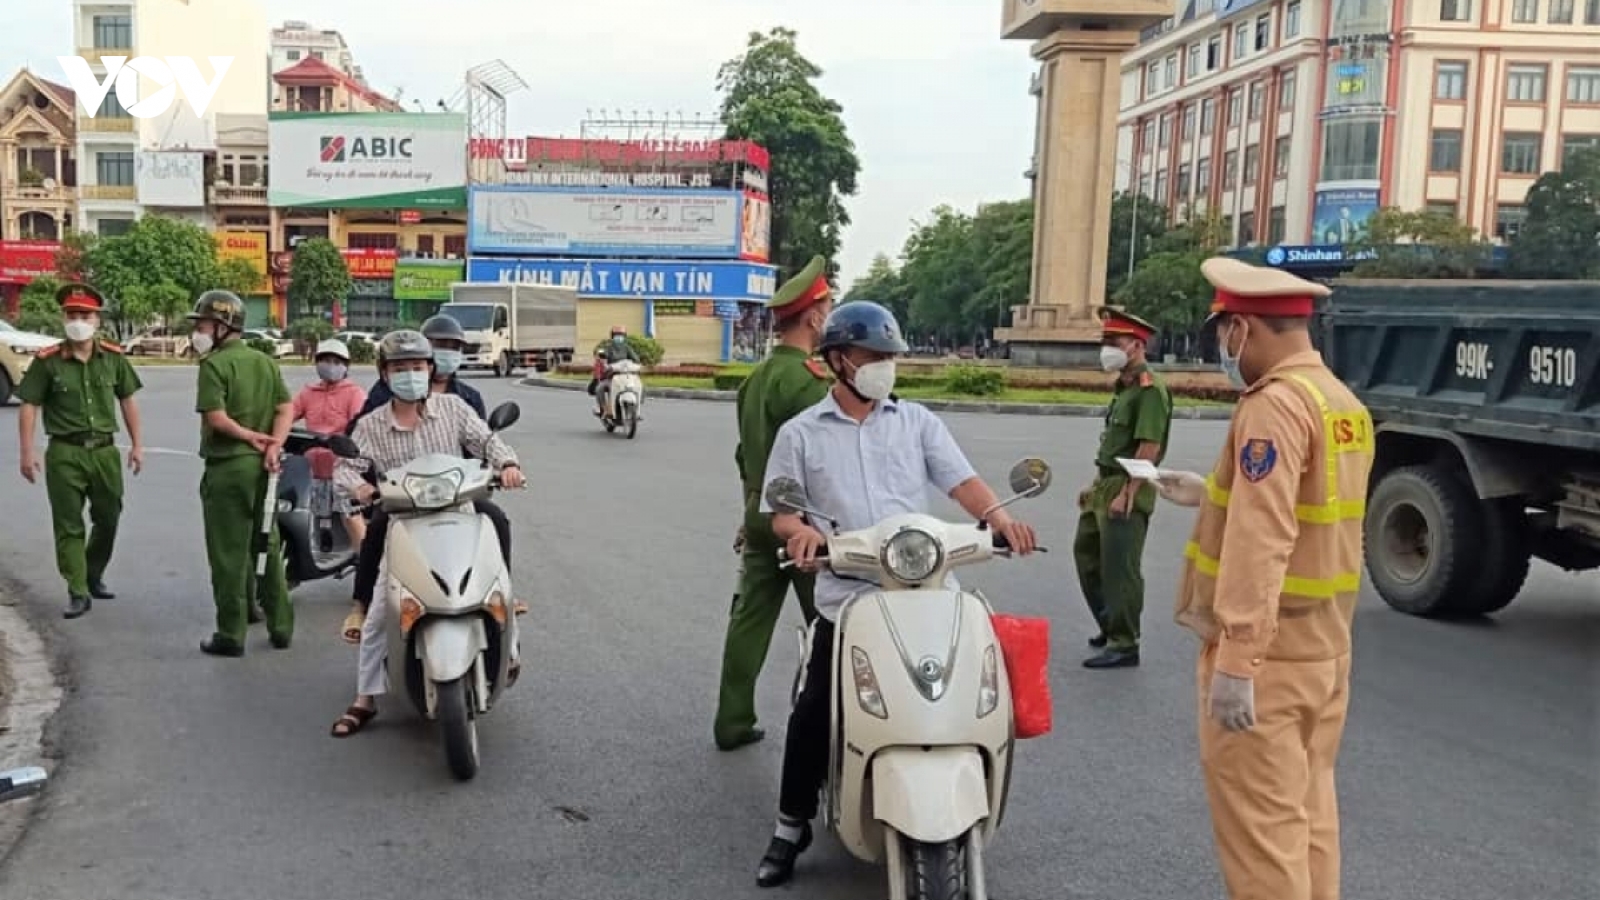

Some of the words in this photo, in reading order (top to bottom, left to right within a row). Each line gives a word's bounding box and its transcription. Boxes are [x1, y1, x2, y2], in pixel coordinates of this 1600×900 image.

[351, 136, 413, 158] ABIC
[1287, 249, 1342, 260] Shinhan
[1346, 246, 1379, 260] ank
[499, 264, 553, 286] KÍNH
[560, 261, 608, 291] MẮT
[620, 271, 664, 296] VẠN
[674, 266, 713, 293] TÍN
[1529, 345, 1576, 387] 9510
